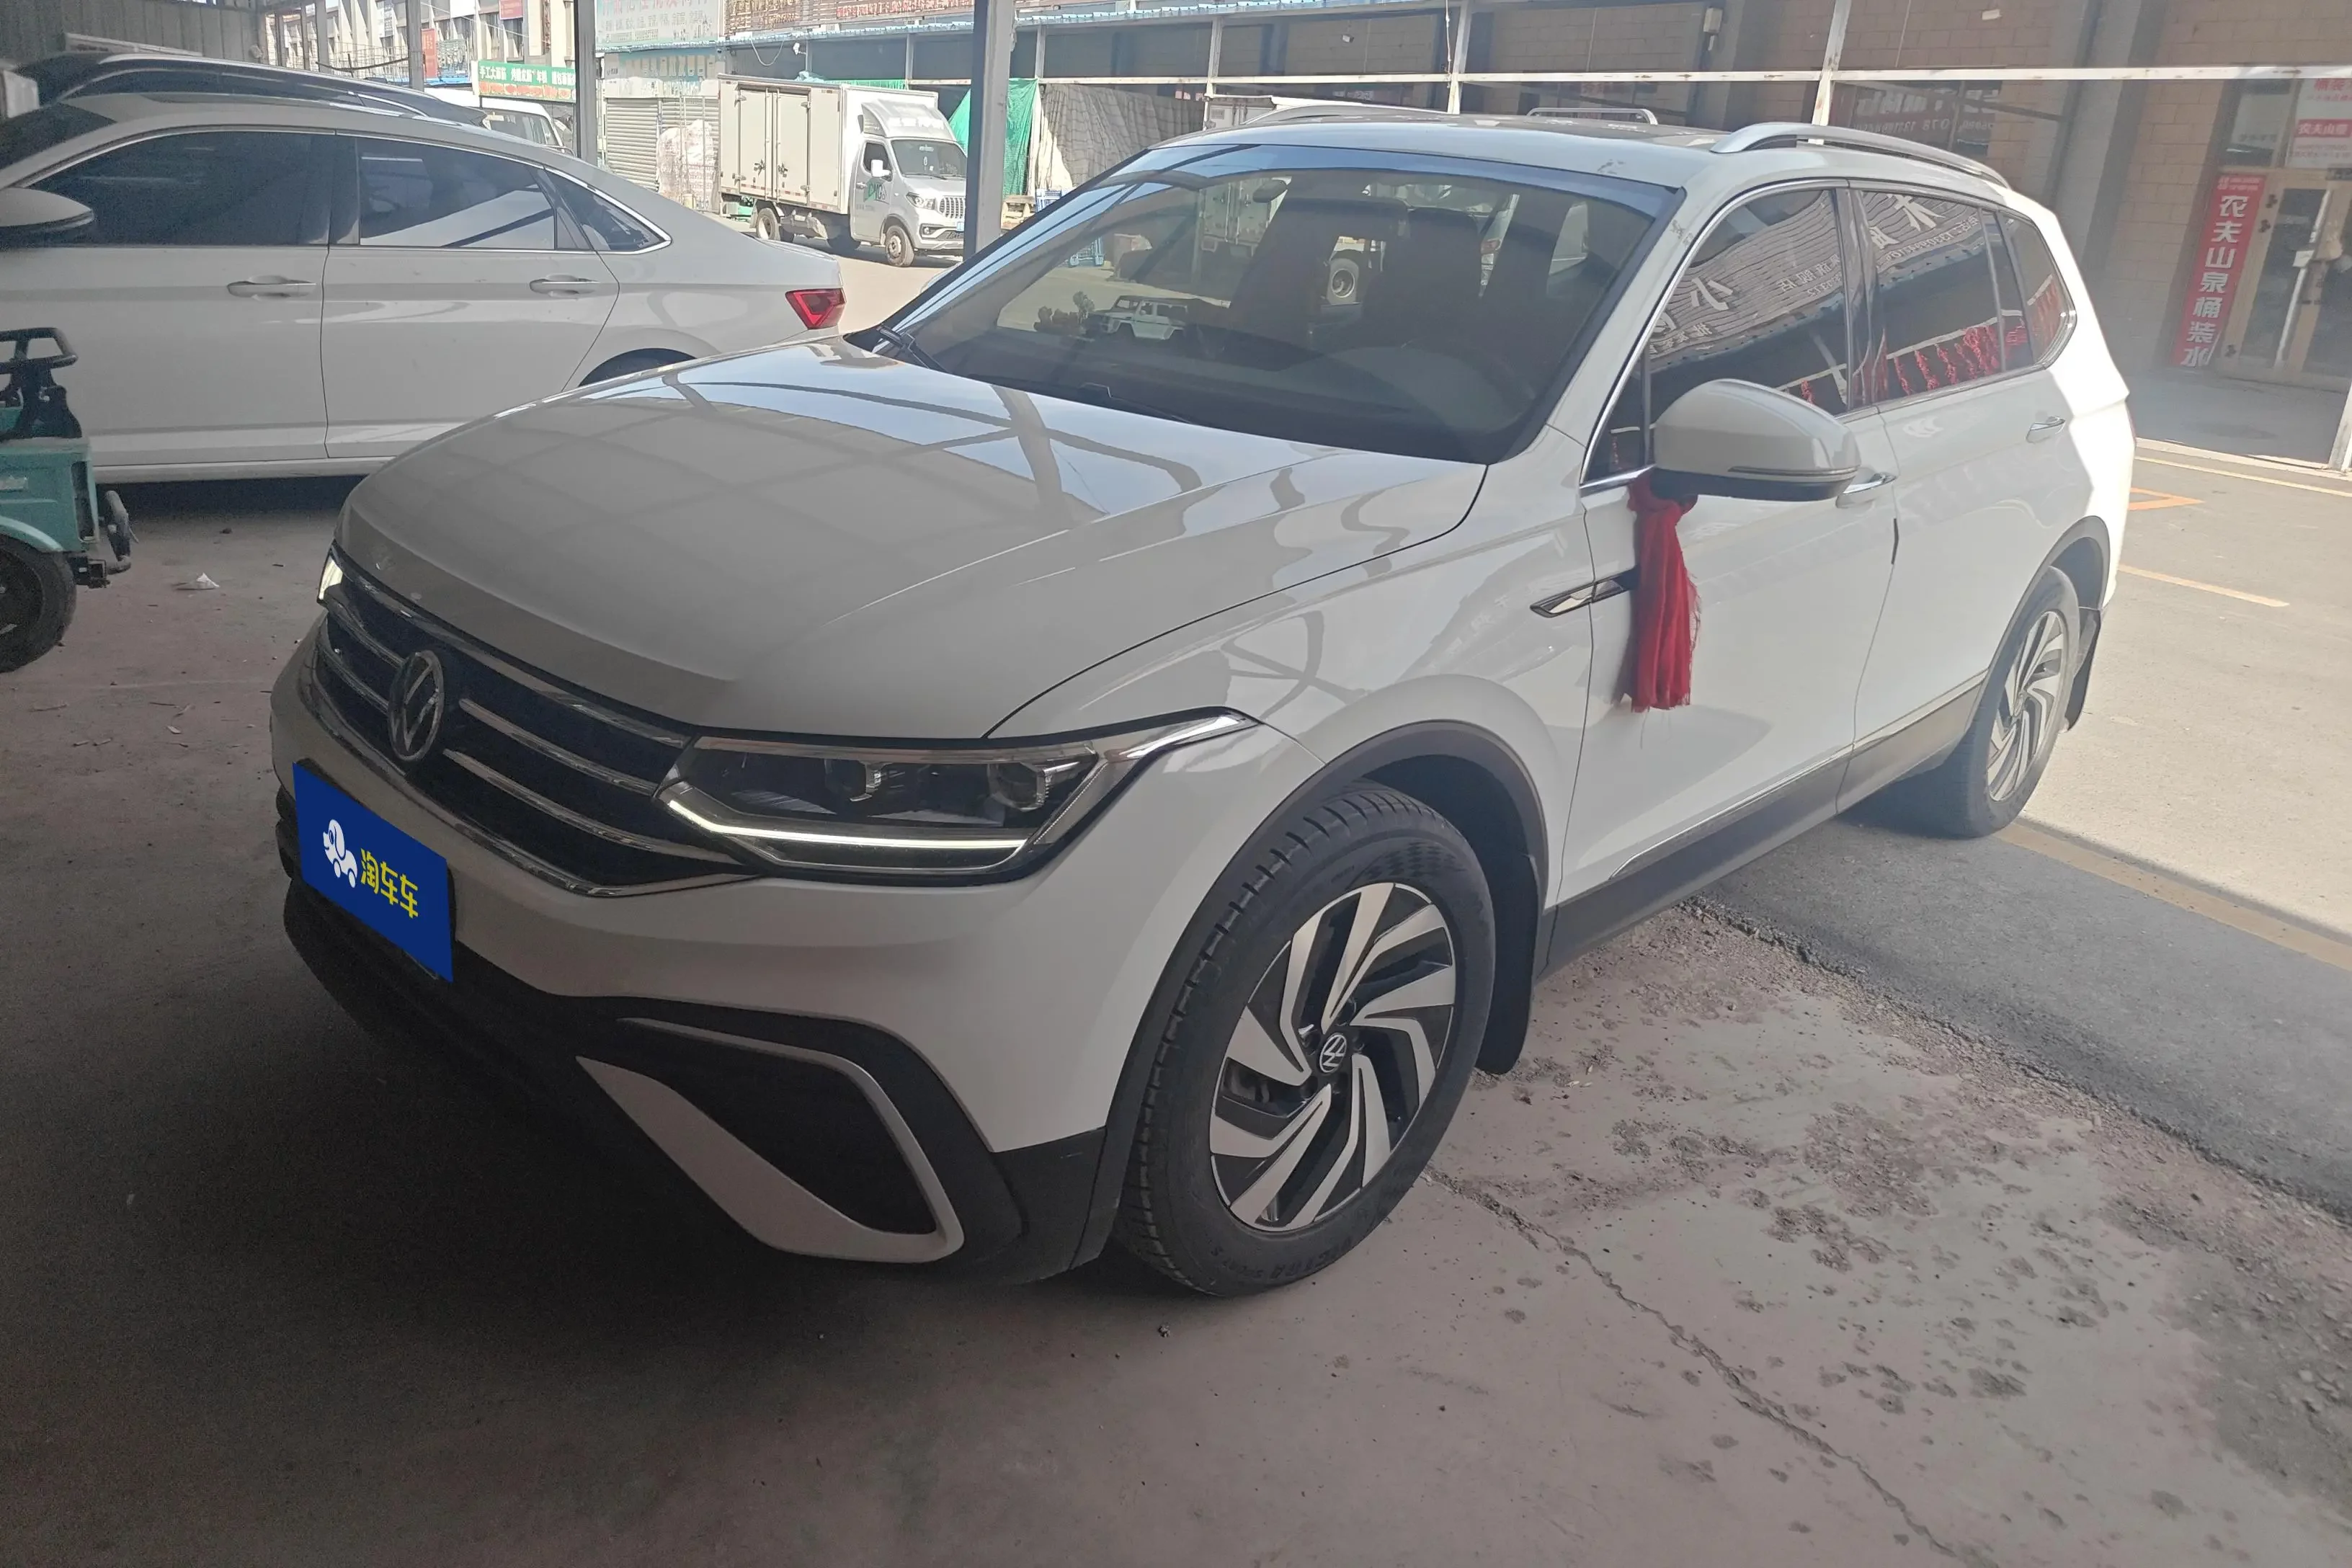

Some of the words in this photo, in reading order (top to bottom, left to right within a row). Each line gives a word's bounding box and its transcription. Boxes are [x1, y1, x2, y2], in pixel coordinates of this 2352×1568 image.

[2180, 195, 2250, 368] 农夫山泉桶装水
